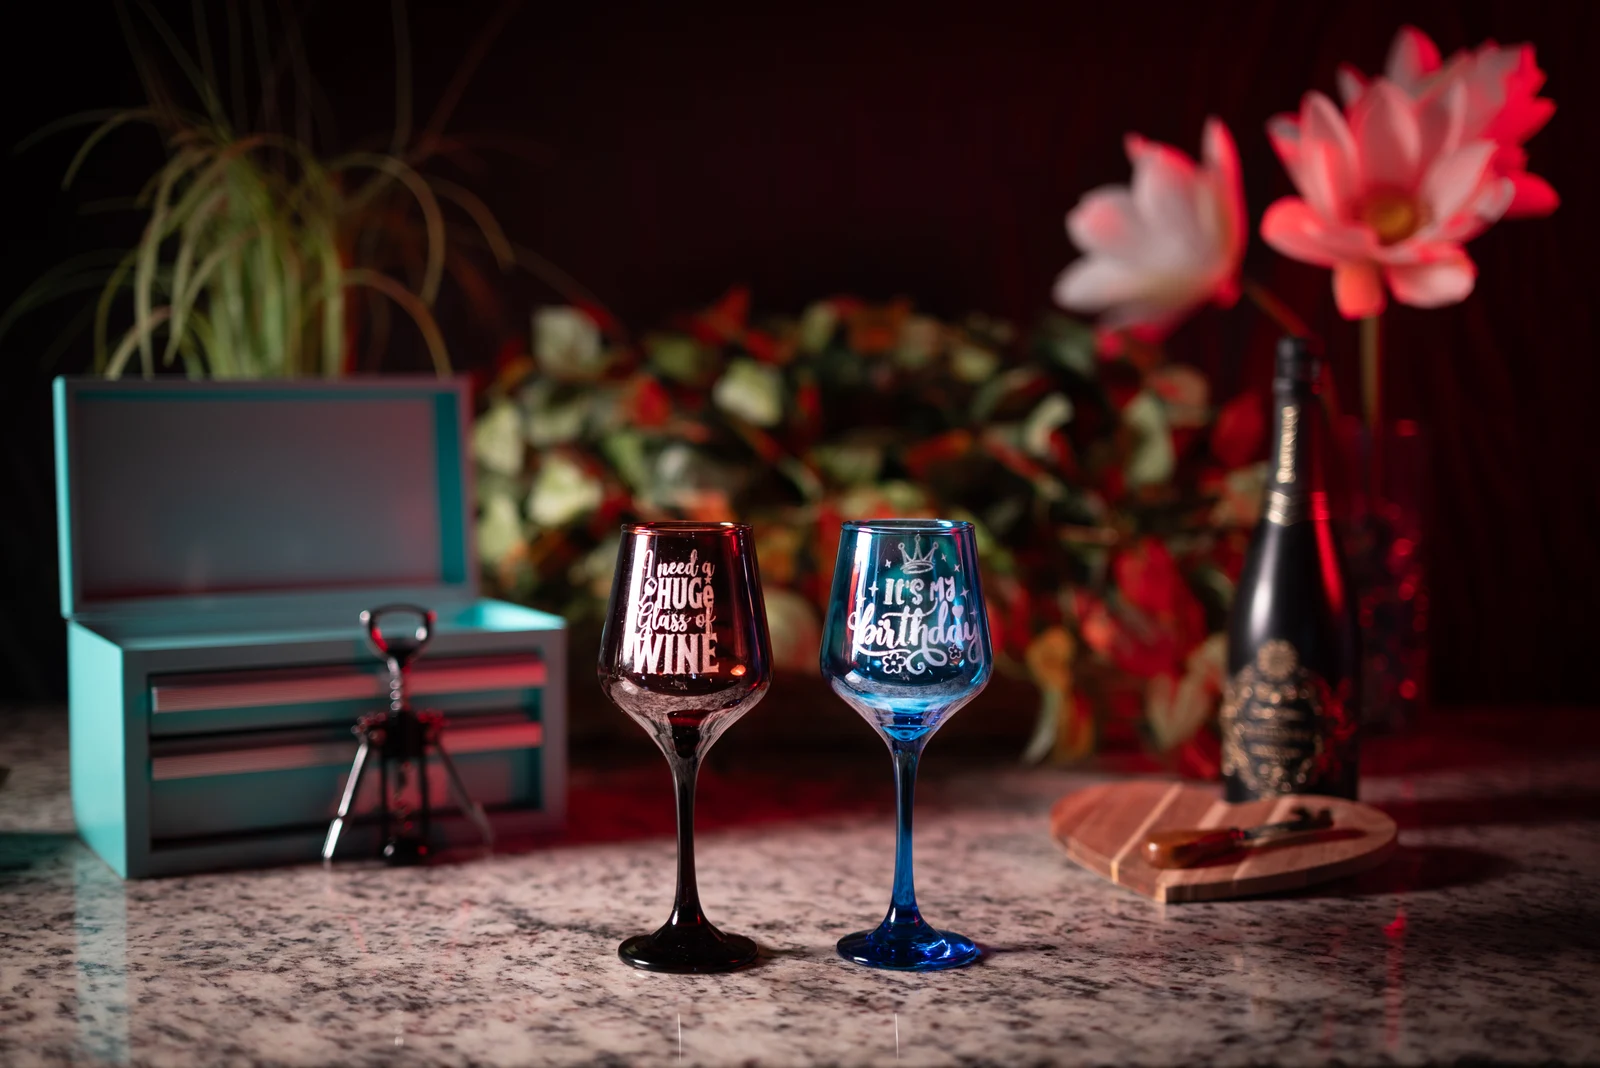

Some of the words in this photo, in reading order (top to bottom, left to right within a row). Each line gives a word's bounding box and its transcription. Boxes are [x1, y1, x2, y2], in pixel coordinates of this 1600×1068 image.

[643, 549, 654, 578] I
[657, 549, 699, 577] need
[702, 561, 715, 577] a
[637, 601, 691, 640] Glass
[695, 606, 716, 637] of
[847, 601, 984, 675] birthday
[633, 633, 719, 674] WINE
